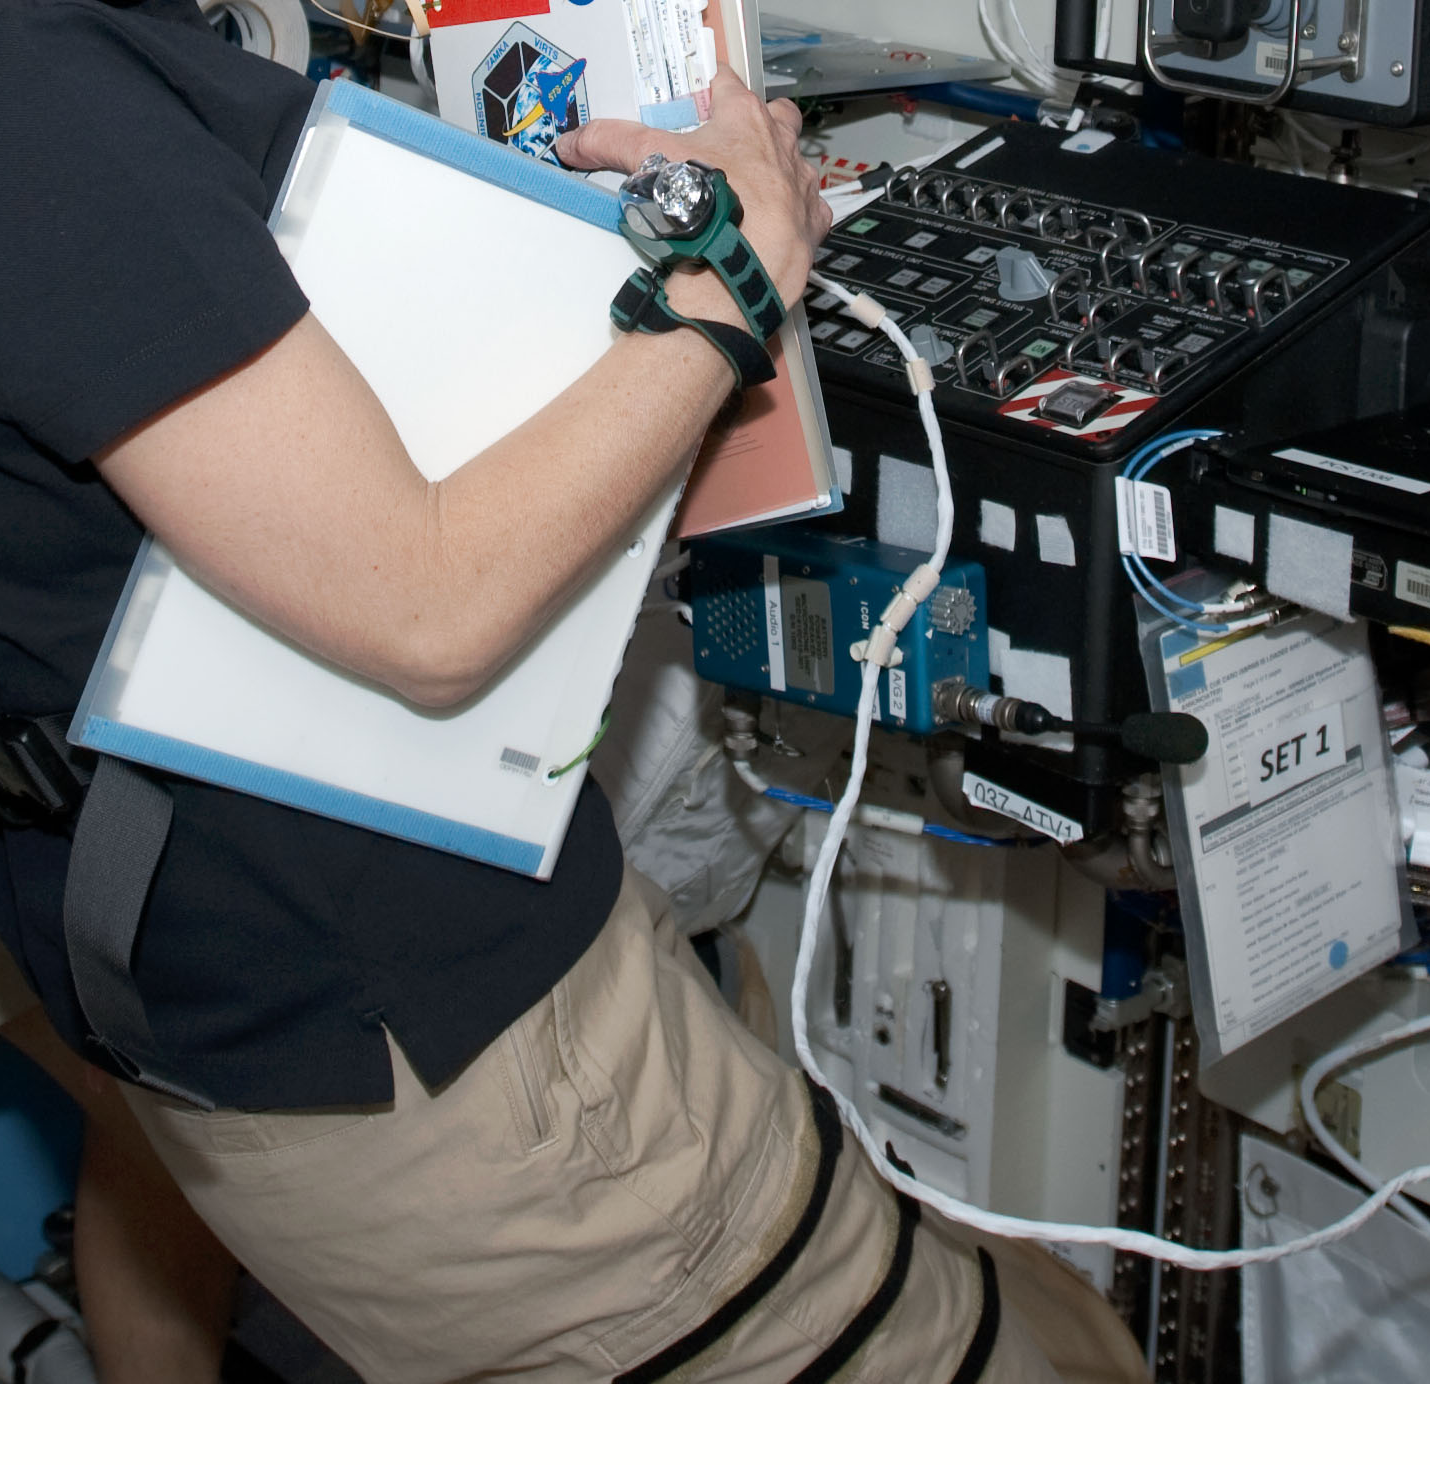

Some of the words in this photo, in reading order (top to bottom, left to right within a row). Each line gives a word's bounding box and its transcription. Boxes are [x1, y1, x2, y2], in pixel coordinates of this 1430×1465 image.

[485, 40, 510, 71] ZAMKA
[534, 37, 559, 61] VIRTS
[1029, 343, 1049, 353] ON
[768, 599, 780, 636] Audio
[859, 600, 870, 631] ICOM
[891, 671, 903, 701] A/G
[892, 702, 903, 710] 2
[1259, 732, 1308, 783] SET
[1315, 724, 1331, 757] 1
